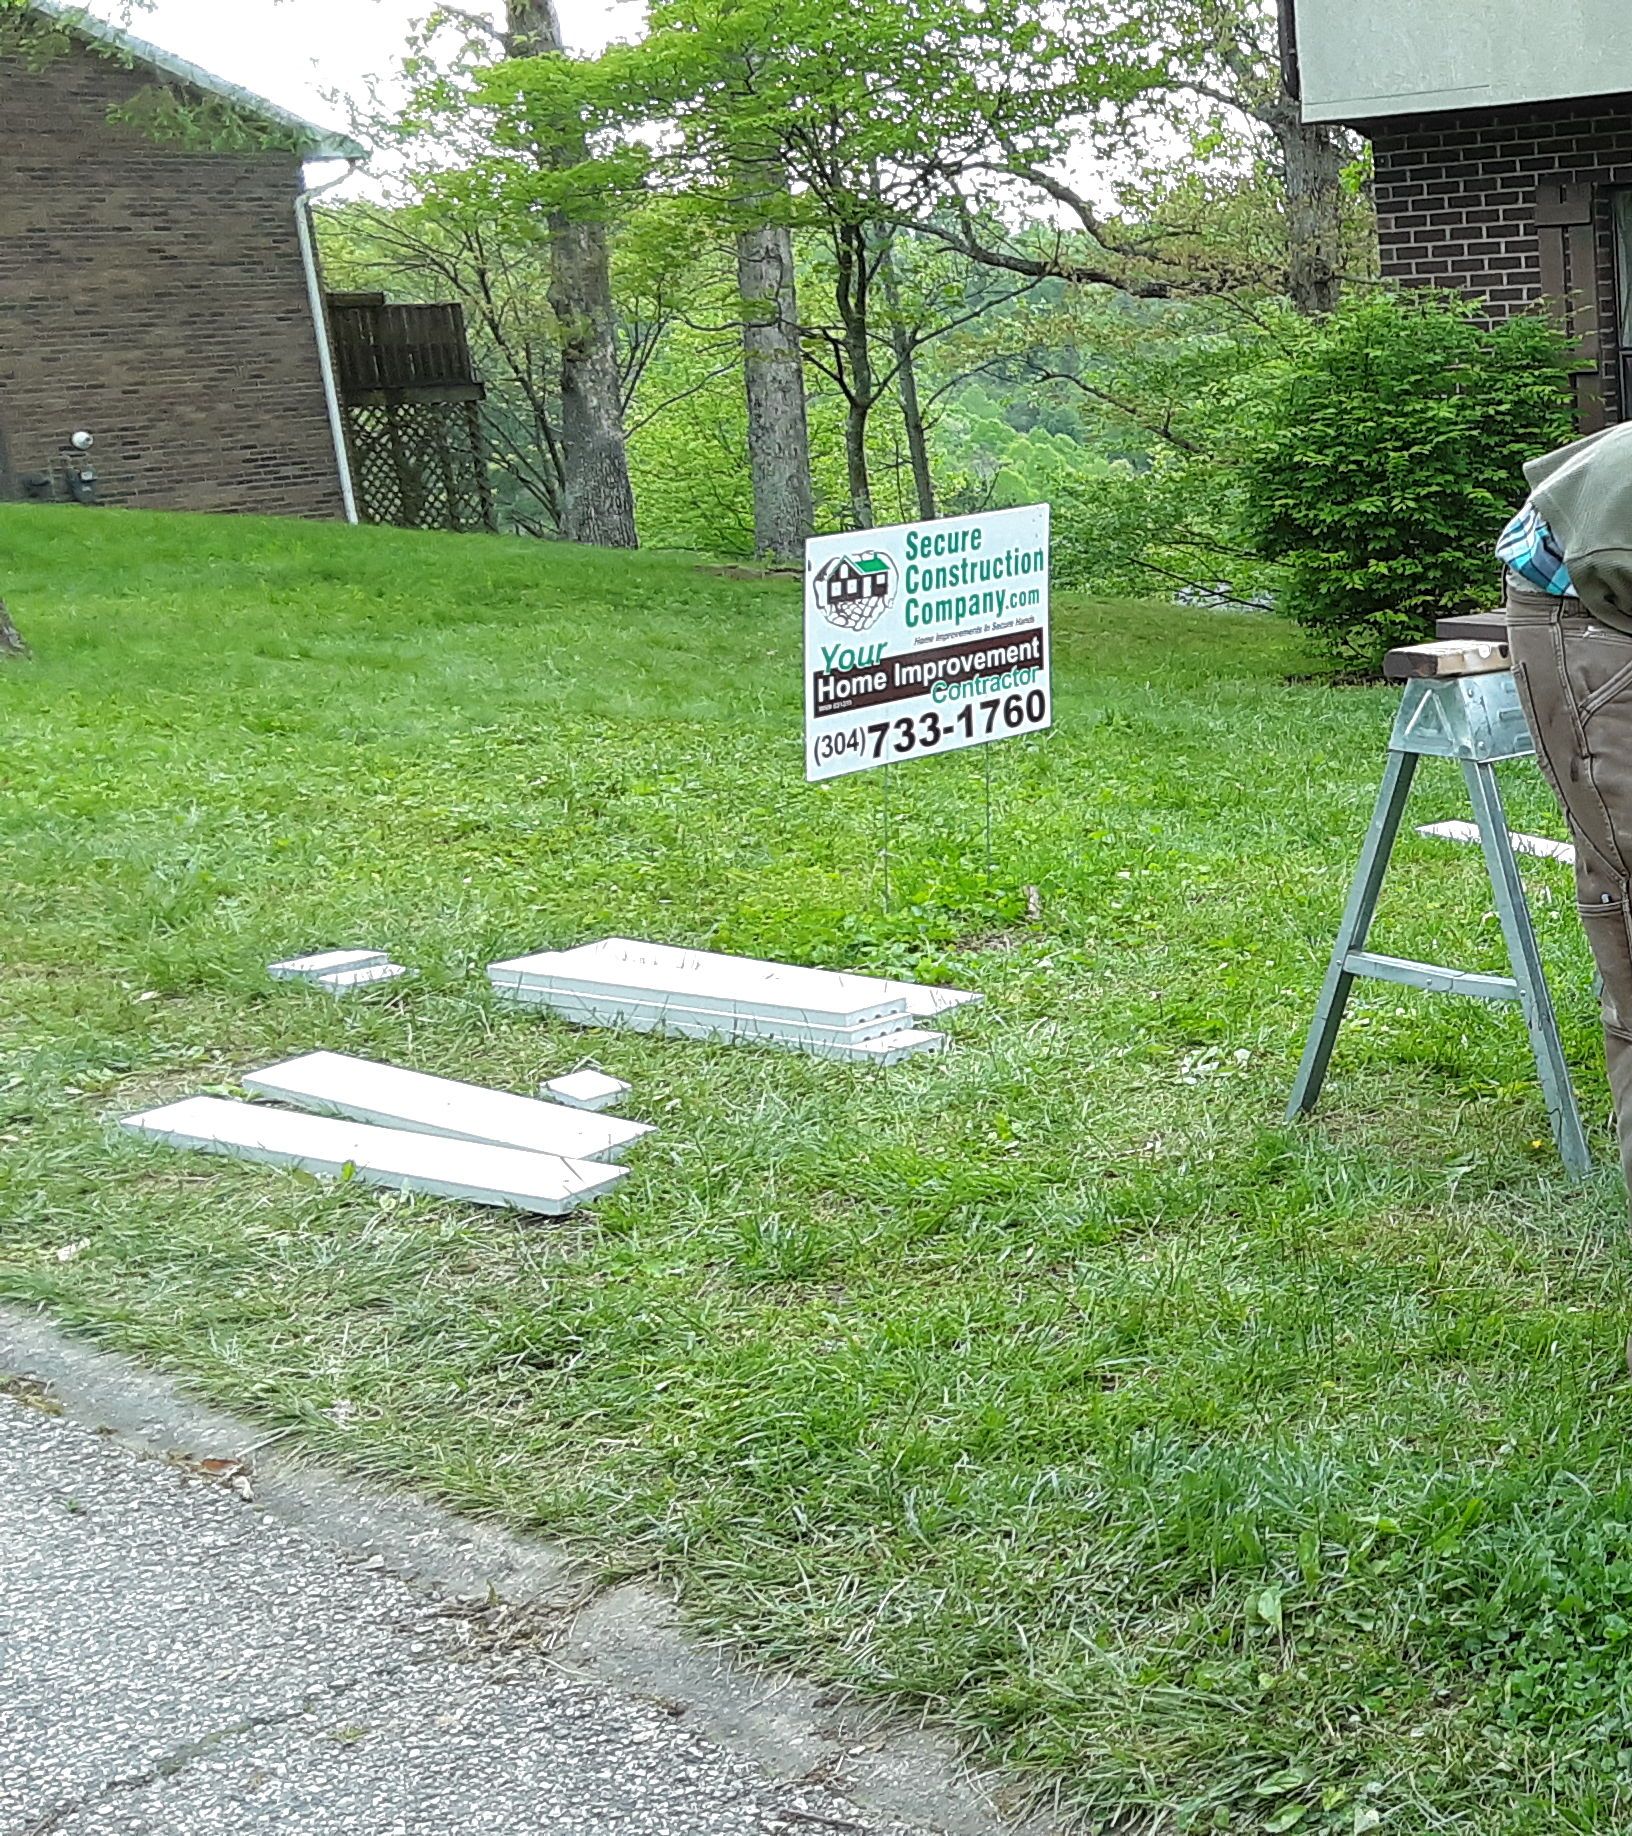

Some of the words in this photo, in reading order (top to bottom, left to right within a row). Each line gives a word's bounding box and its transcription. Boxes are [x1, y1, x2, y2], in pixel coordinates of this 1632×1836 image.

[905, 527, 982, 561] Secure
[905, 547, 1044, 594] Construction
[905, 588, 1040, 628] Company.com
[818, 670, 887, 702] Home
[894, 636, 1040, 687] Improvement
[820, 641, 888, 675] Your
[932, 665, 1040, 704] Contractor
